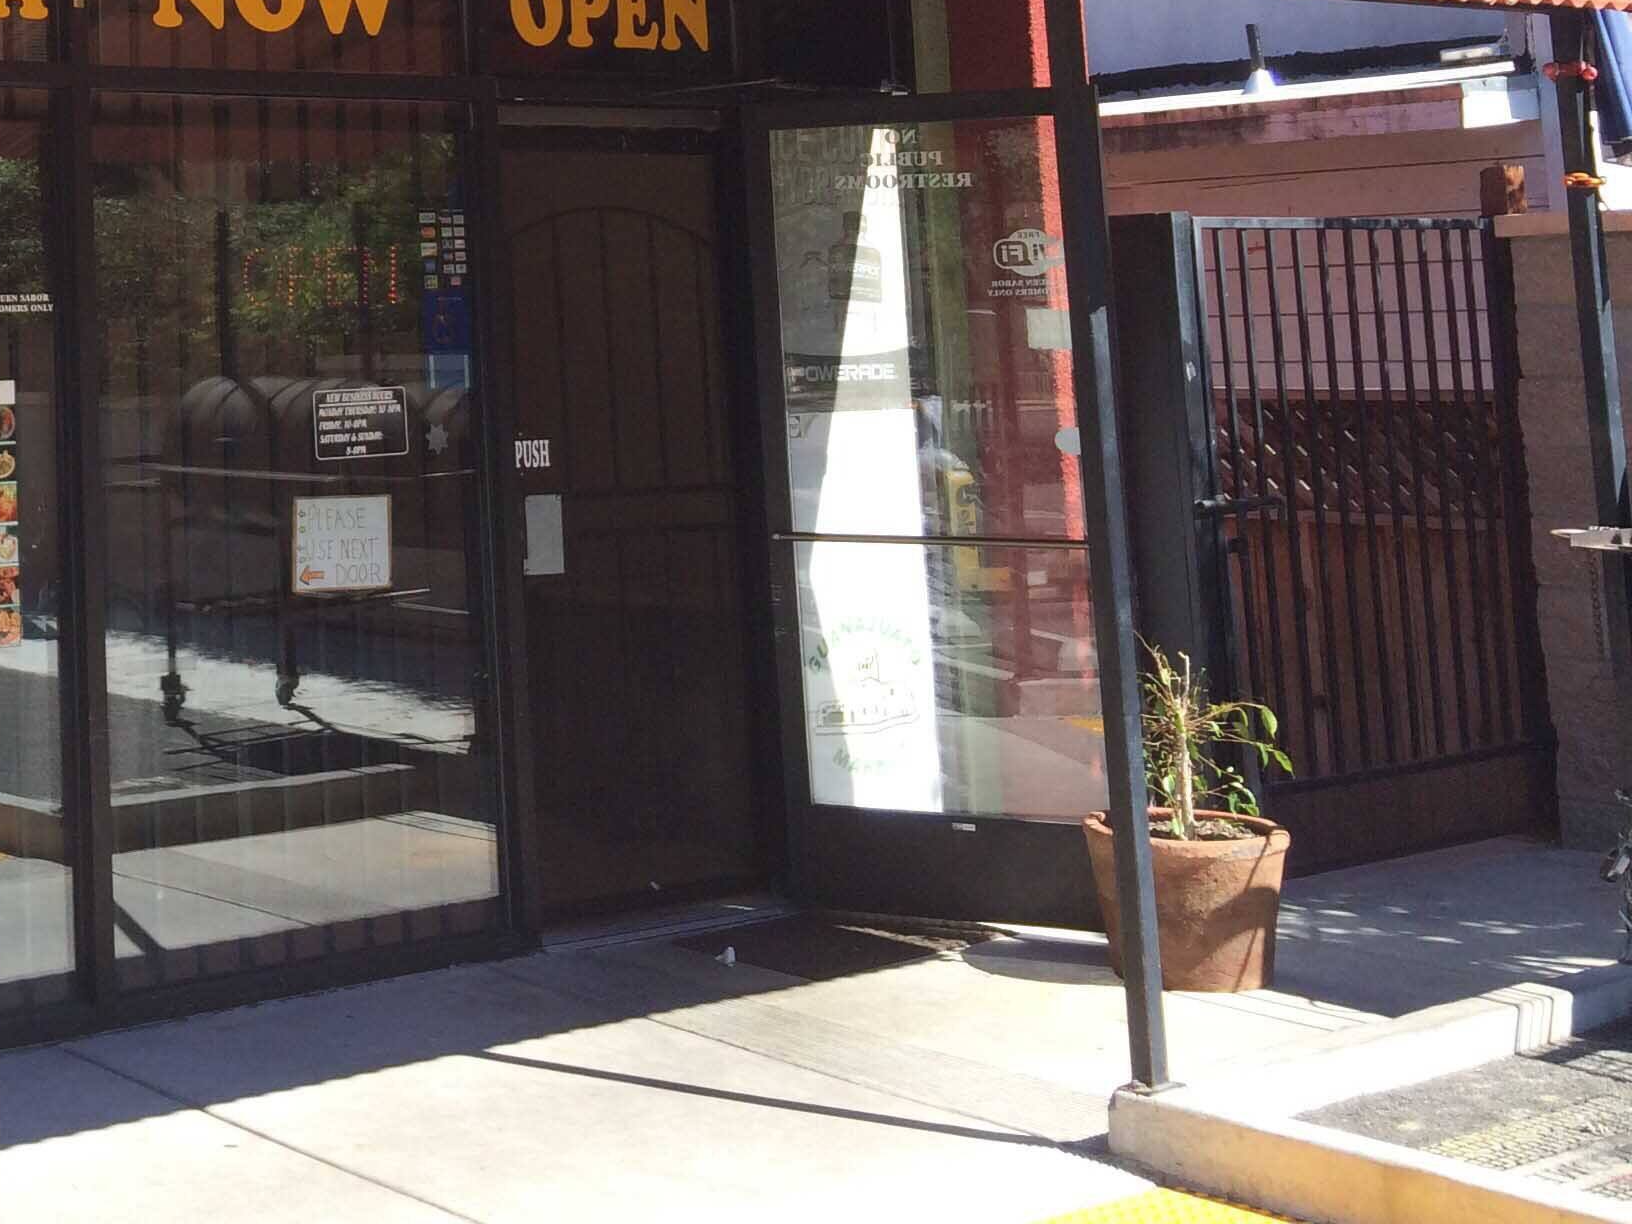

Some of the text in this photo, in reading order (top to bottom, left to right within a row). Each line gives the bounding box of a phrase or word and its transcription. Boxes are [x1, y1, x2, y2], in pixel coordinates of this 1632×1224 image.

[20, 293, 49, 302] SABOR
[30, 303, 54, 312] ONLY
[514, 439, 551, 468] PUSH
[307, 503, 366, 531] PLEASE
[337, 536, 381, 560] NEXT
[335, 562, 384, 584] DOOR
